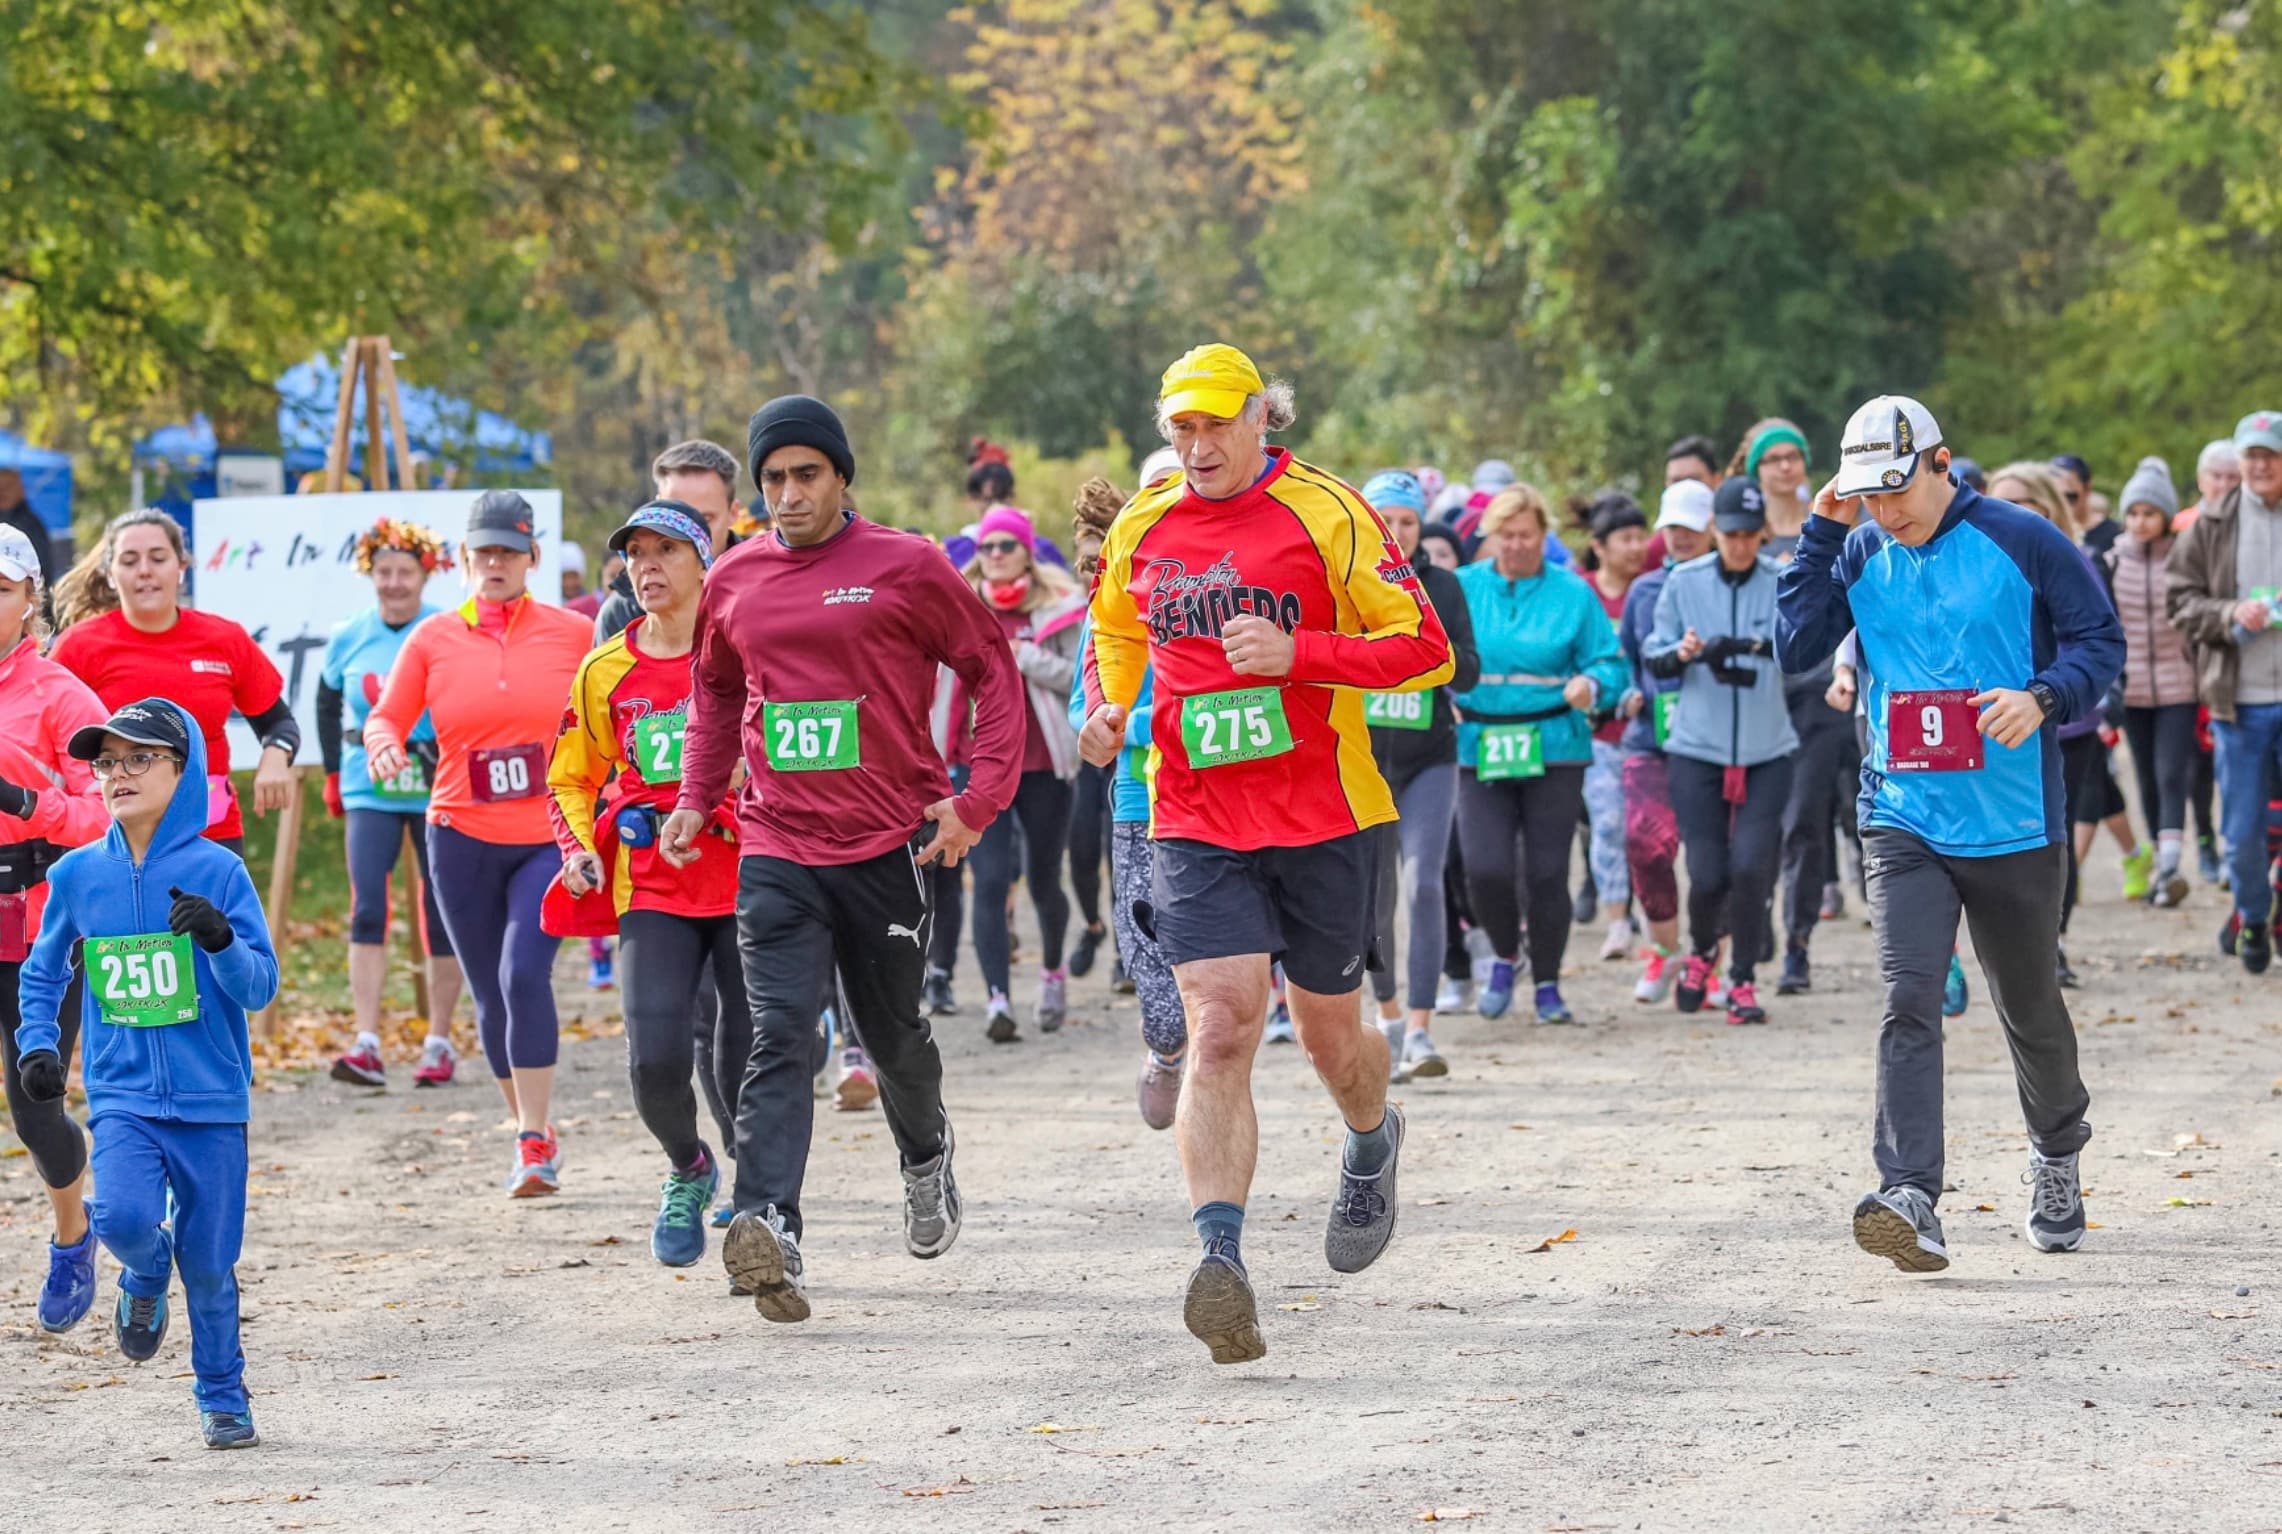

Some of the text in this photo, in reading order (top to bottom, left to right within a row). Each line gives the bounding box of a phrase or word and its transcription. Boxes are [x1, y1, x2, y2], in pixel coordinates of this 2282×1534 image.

[205, 538, 263, 570] Art
[288, 531, 322, 567] In
[1368, 688, 1422, 721] 206
[776, 717, 842, 758] 267
[1195, 705, 1273, 756] 275
[1921, 705, 1943, 747] 9
[1485, 734, 1531, 763] 217
[488, 756, 529, 794] 80
[136, 939, 173, 951] Motion
[101, 951, 179, 999] 250
